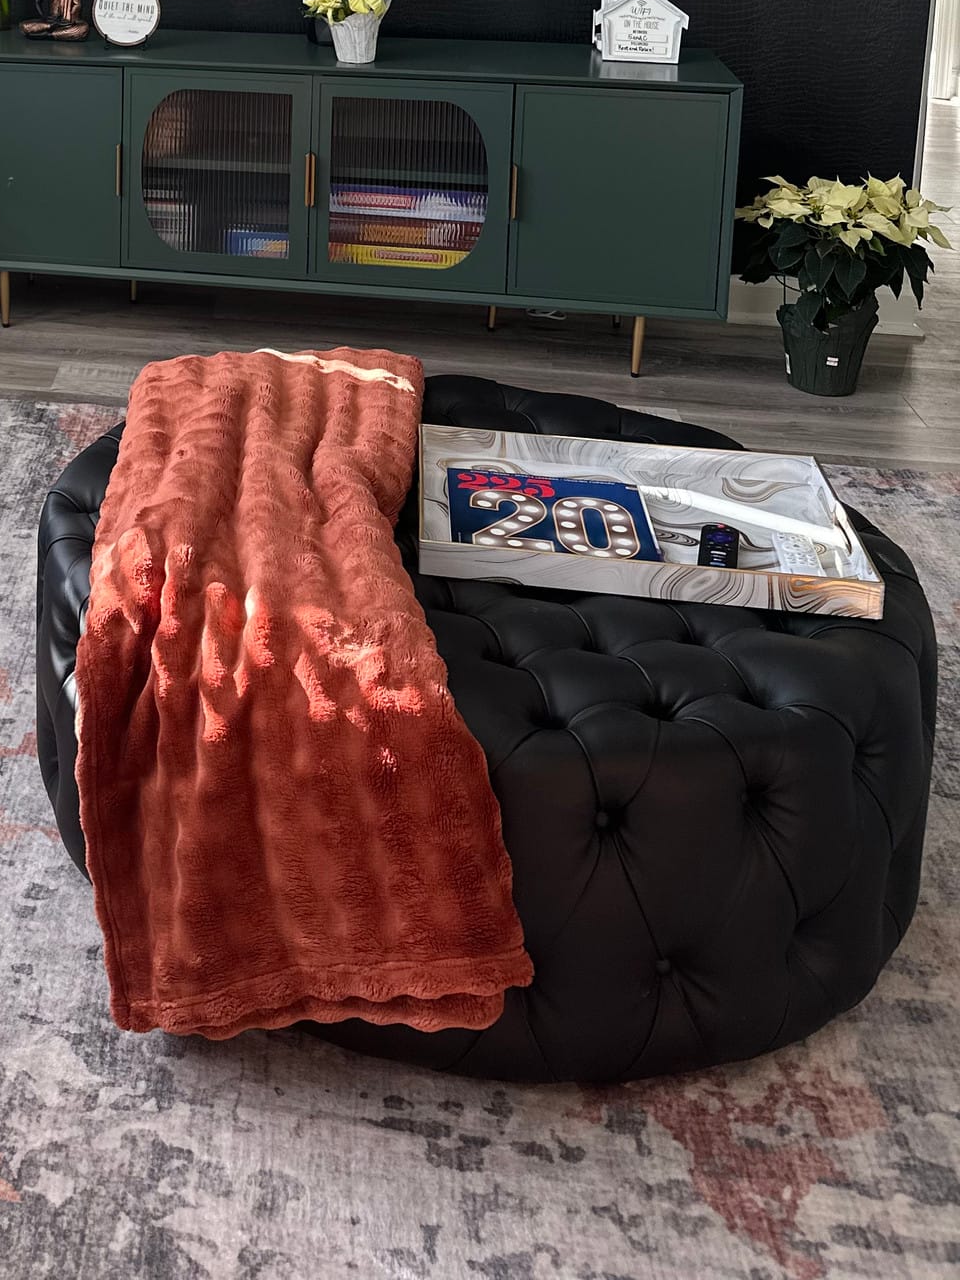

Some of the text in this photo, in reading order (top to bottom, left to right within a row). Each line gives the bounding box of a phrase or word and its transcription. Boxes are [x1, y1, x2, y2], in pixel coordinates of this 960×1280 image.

[137, 3, 155, 14] MIND
[456, 472, 556, 498] 225
[469, 489, 640, 559] 20
